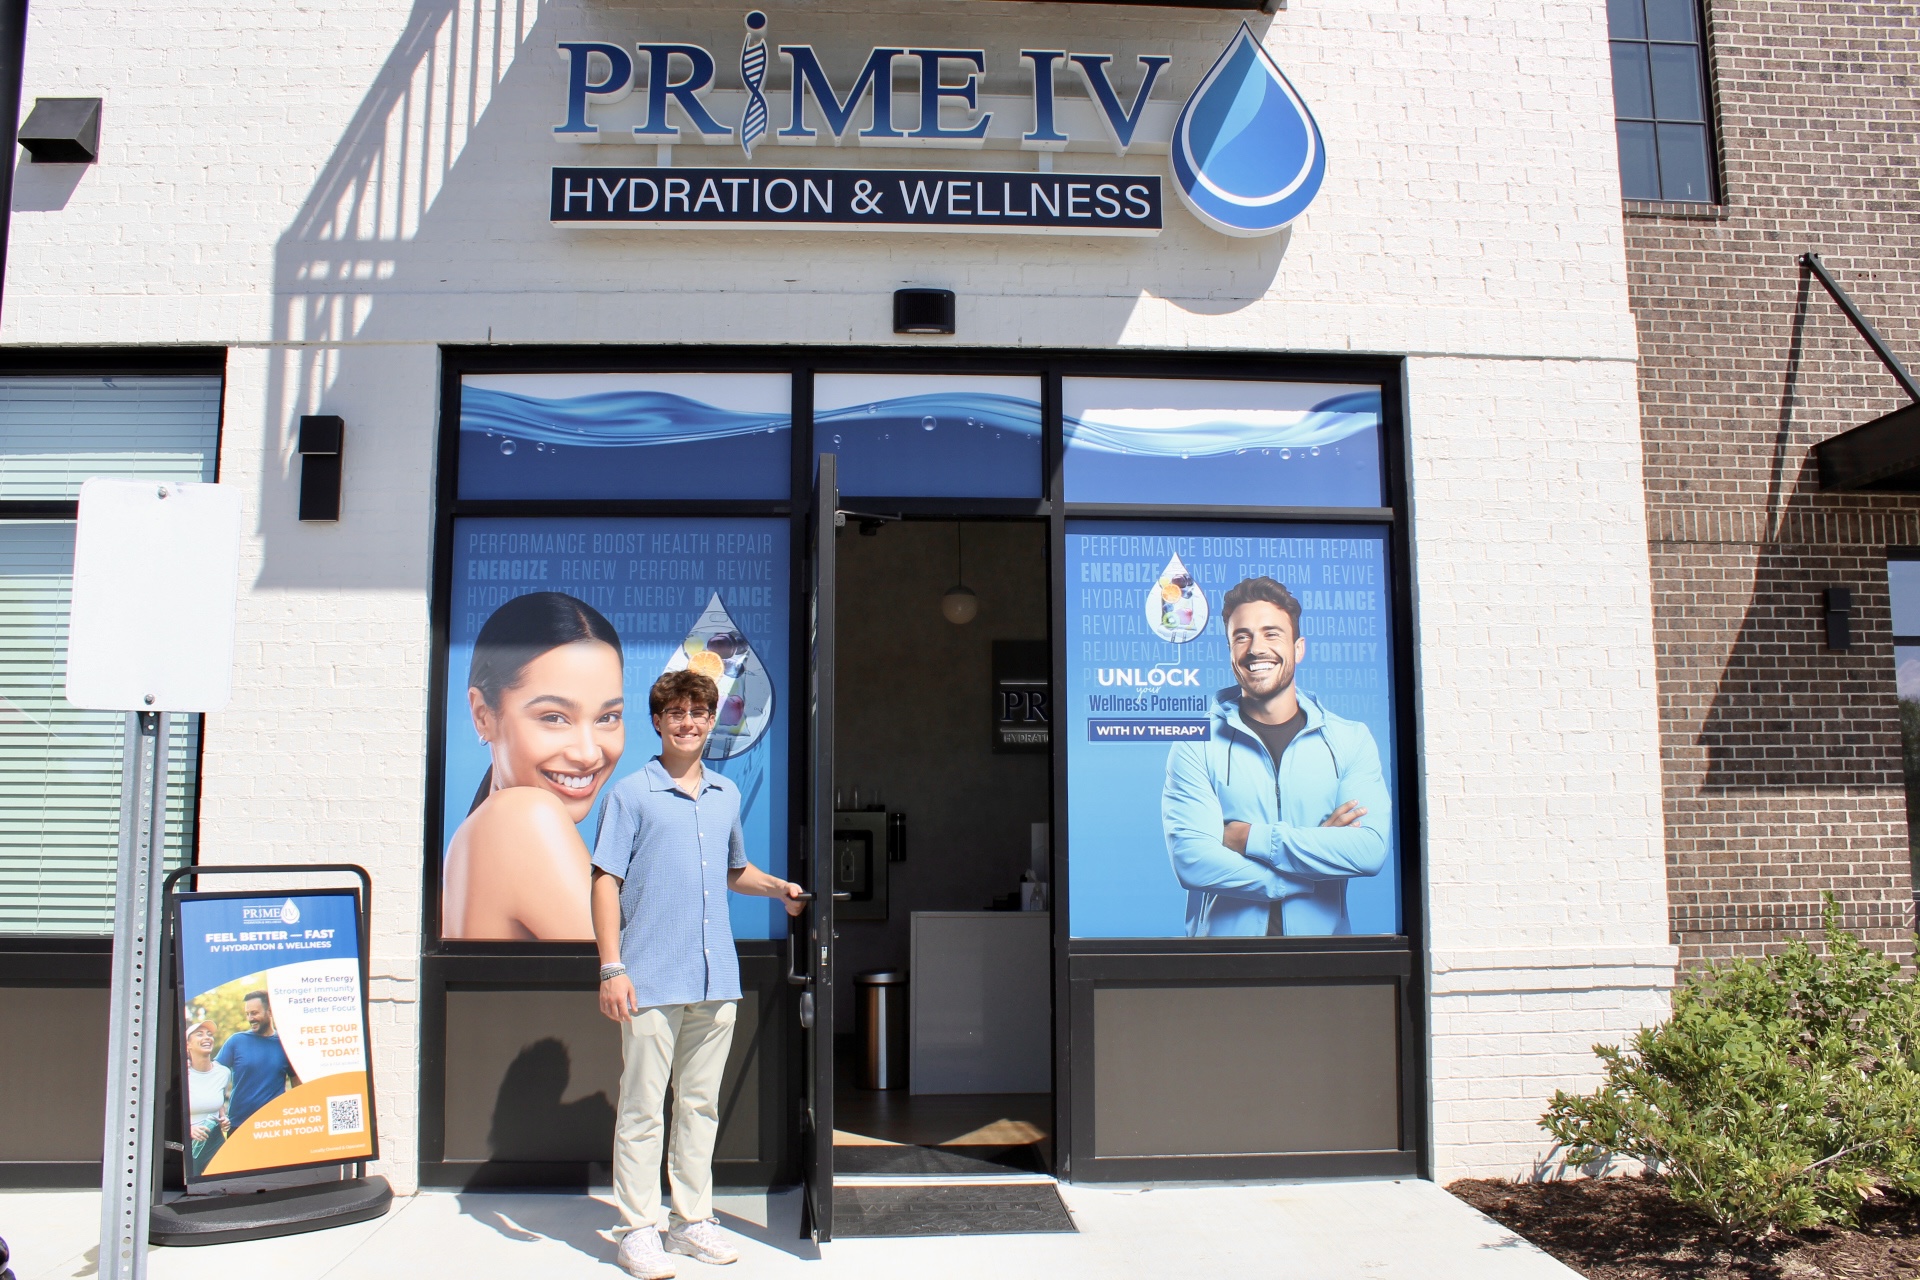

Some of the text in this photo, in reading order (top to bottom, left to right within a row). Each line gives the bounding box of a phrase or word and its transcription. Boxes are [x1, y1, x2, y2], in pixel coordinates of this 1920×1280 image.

[1019, 48, 1173, 156] IV
[562, 178, 1152, 219] HYDRATION & WELLNESS
[469, 533, 772, 553] PERFORMANCE BOOST HEALTH REPAIR
[1081, 536, 1374, 559] PERFORMANCE BOOST HEALTH REPAIR
[468, 559, 772, 580] ENERGIZE RENEW PERFORM REVIVE
[1081, 562, 1375, 585] ENERGIZE NEW PERFORM REVIVE
[467, 586, 538, 606] HYDR
[547, 587, 615, 606] LITY
[624, 587, 686, 606] ENERGY
[1302, 590, 1376, 610] BALANCE
[675, 613, 772, 633] ENNCE
[1082, 614, 1376, 636] REVITAL DURANCE
[1083, 641, 1377, 662] REJUVENATE HEAL FORTIFY
[1097, 668, 1200, 687] UNLOCK
[1325, 668, 1378, 689] REPAIR
[1089, 694, 1207, 712] Wellness Potential
[1136, 685, 1161, 704] your
[1325, 694, 1379, 715] PROVE
[1003, 733, 1048, 743] HYDRATI
[1096, 725, 1206, 736] WITH IV THERAPY
[205, 933, 238, 943] FEEL
[240, 931, 288, 942] BETTER
[304, 929, 335, 940] FAST
[210, 940, 332, 953] IV HYDRATION & WELLNESS
[301, 975, 354, 984] More Energy
[274, 985, 355, 996] Stronger Immunity
[288, 995, 356, 1005] Faster Recovery
[303, 1004, 357, 1014] Better Focus
[300, 1023, 358, 1035] FREE TOUR
[307, 1037, 329, 1047] B-12
[331, 1035, 359, 1045] SHOT
[321, 1047, 360, 1058] TODAY!
[282, 1104, 321, 1116] SCAN TO
[254, 1115, 322, 1130] BOOK NOW OR
[253, 1125, 325, 1140] WALK IN TODAY
[860, 1202, 1011, 1213] WELCOME
